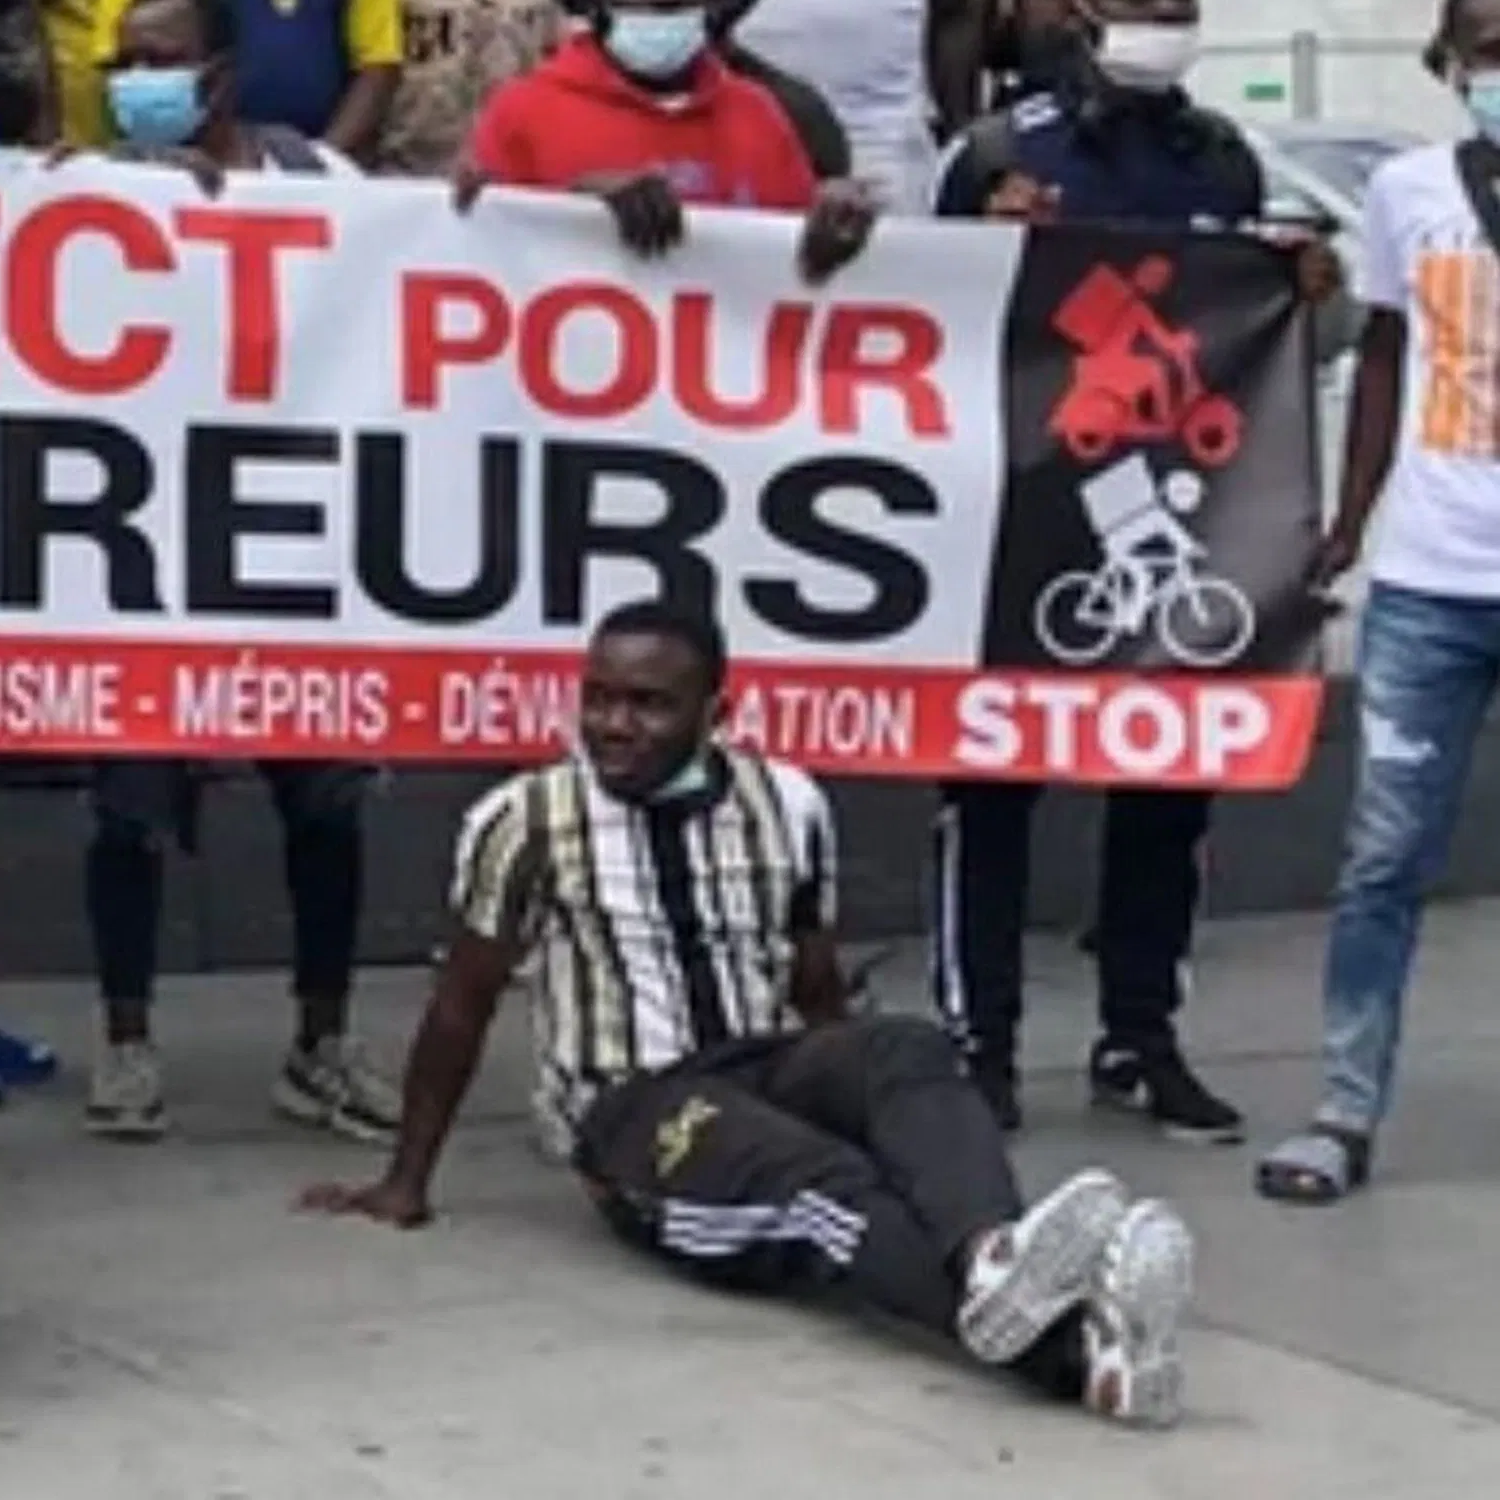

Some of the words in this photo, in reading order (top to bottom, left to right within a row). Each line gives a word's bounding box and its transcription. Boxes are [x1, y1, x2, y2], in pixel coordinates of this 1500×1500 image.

[401, 270, 951, 440] POUR
[174, 648, 391, 744] MÉPRIS
[953, 677, 1272, 780] STOP
